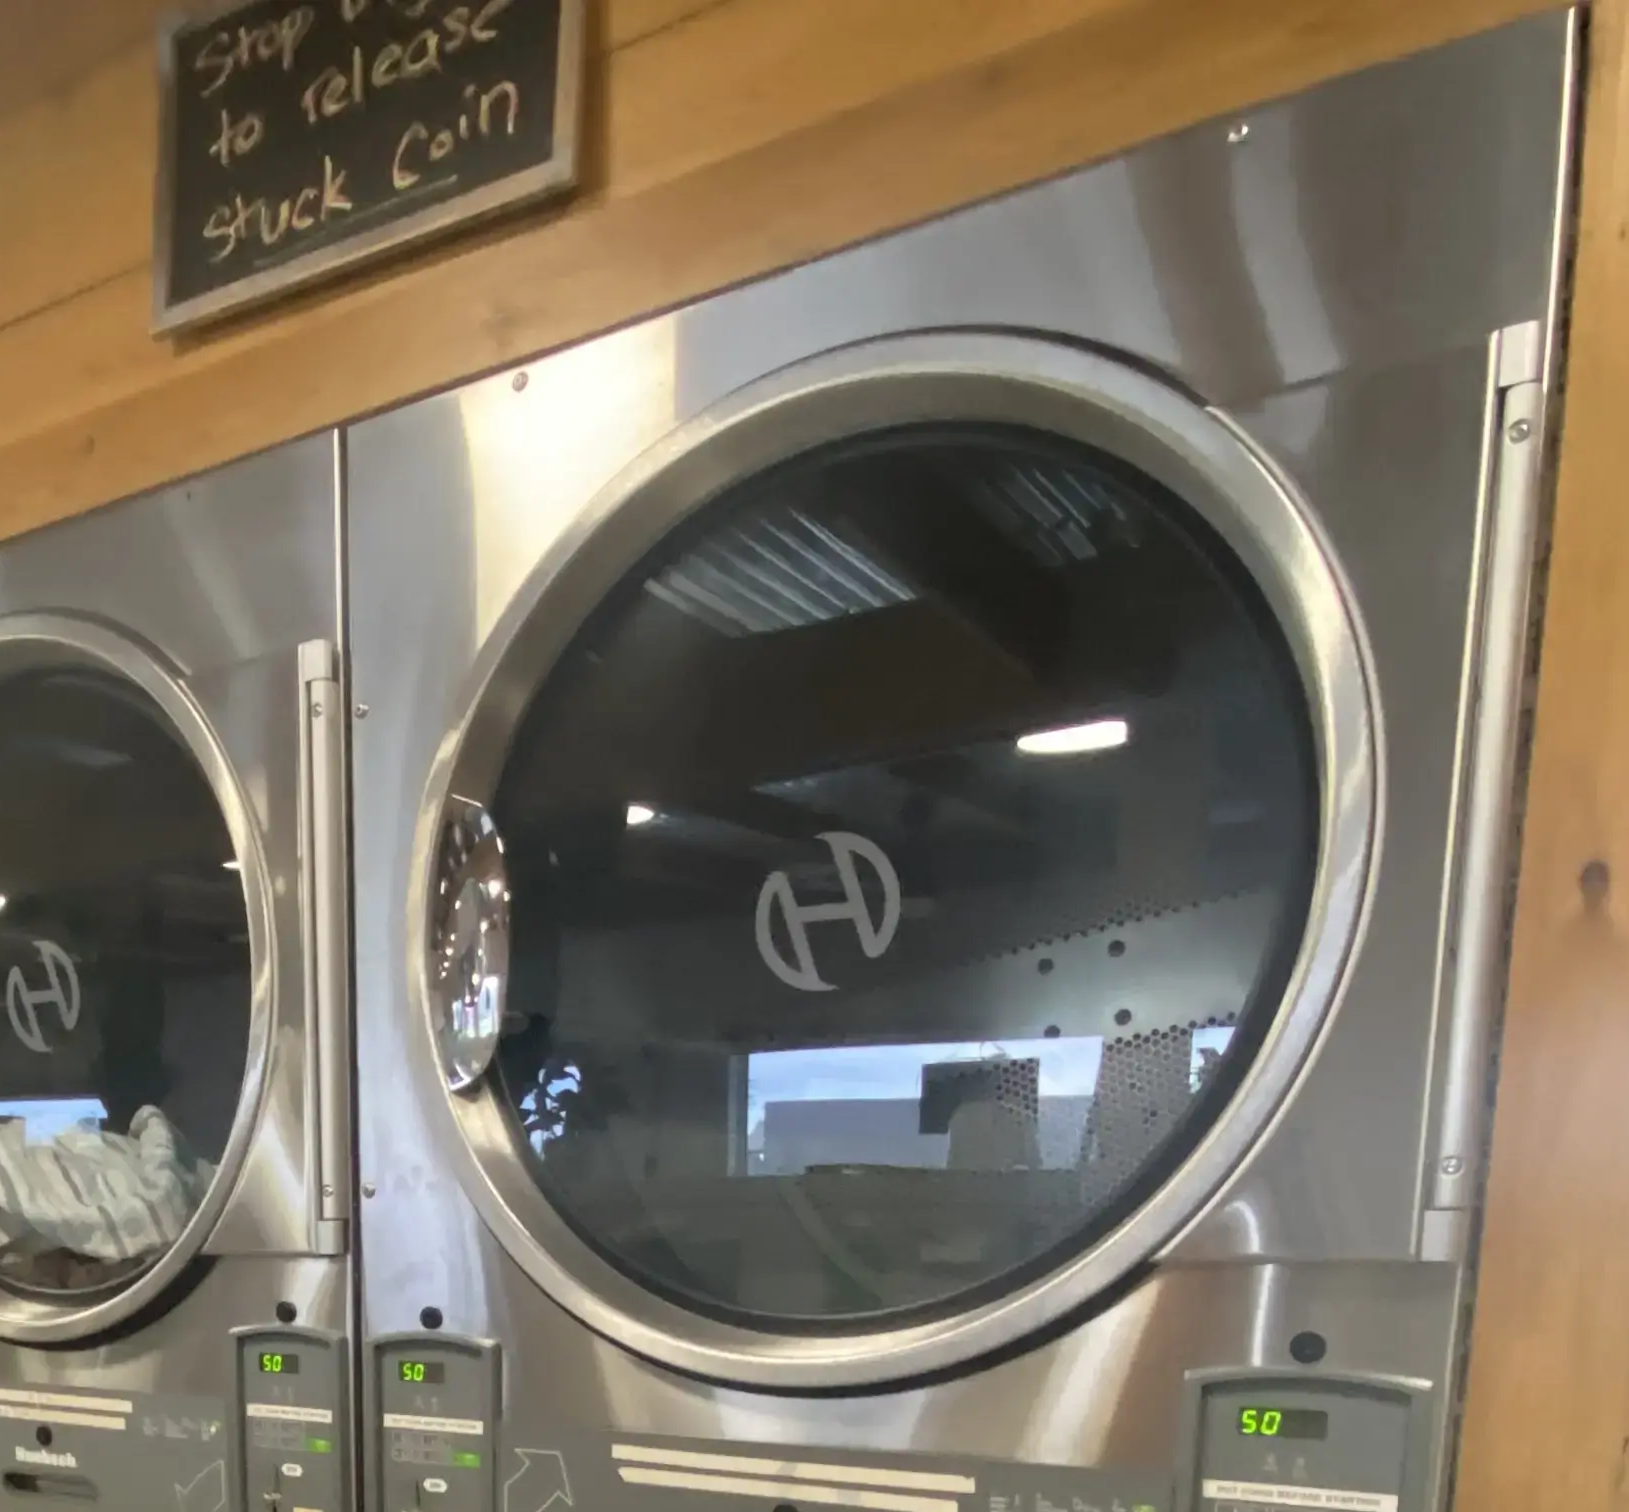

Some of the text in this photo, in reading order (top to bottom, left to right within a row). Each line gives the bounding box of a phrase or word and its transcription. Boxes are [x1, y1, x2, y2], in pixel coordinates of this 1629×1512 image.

[208, 108, 265, 167] to
[262, 1354, 282, 1372] 50
[402, 1363, 425, 1381] 50
[1240, 1409, 1282, 1435] 50
